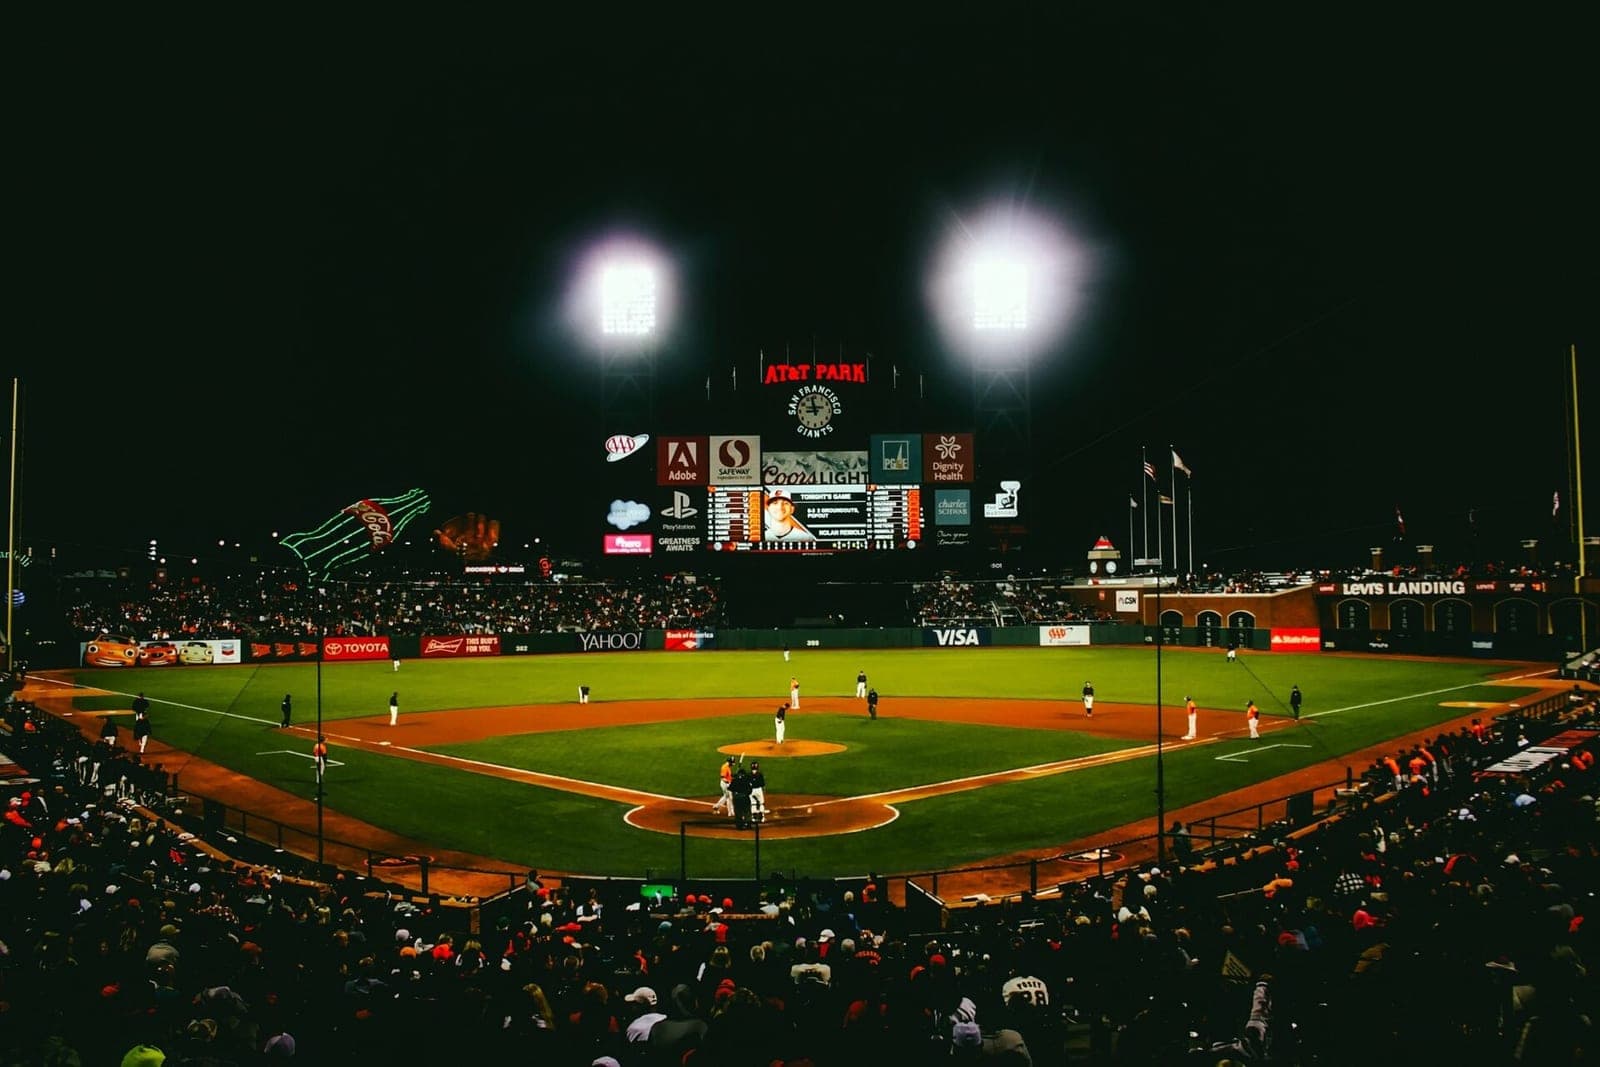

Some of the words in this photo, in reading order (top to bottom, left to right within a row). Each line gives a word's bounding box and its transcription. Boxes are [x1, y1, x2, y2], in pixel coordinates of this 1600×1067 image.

[765, 363, 811, 384] AT&T
[815, 363, 866, 383] PARK
[788, 394, 800, 415] SAN
[798, 385, 841, 415] FRANCISCO
[797, 424, 833, 438] GIANTS
[605, 436, 635, 454] AAA
[932, 462, 964, 473] Dignity
[668, 470, 697, 481] Adobe
[761, 466, 817, 485] Coors
[820, 471, 868, 485] LIGHT
[934, 472, 963, 481] Health
[938, 499, 967, 508] charles
[938, 508, 967, 516] SCHWAB
[362, 511, 392, 545] Cola
[658, 537, 700, 545] GREATNESS
[1388, 581, 1465, 595] LANDING
[1124, 597, 1137, 605] CSN
[666, 631, 682, 639] Bank
[689, 631, 714, 639] America
[932, 629, 980, 646] VISA
[465, 637, 479, 645] THIS
[480, 637, 498, 645] BUD'S
[580, 632, 642, 651] YAHOO!
[343, 643, 389, 653] TOYOTA
[1016, 981, 1042, 990] POSEY
